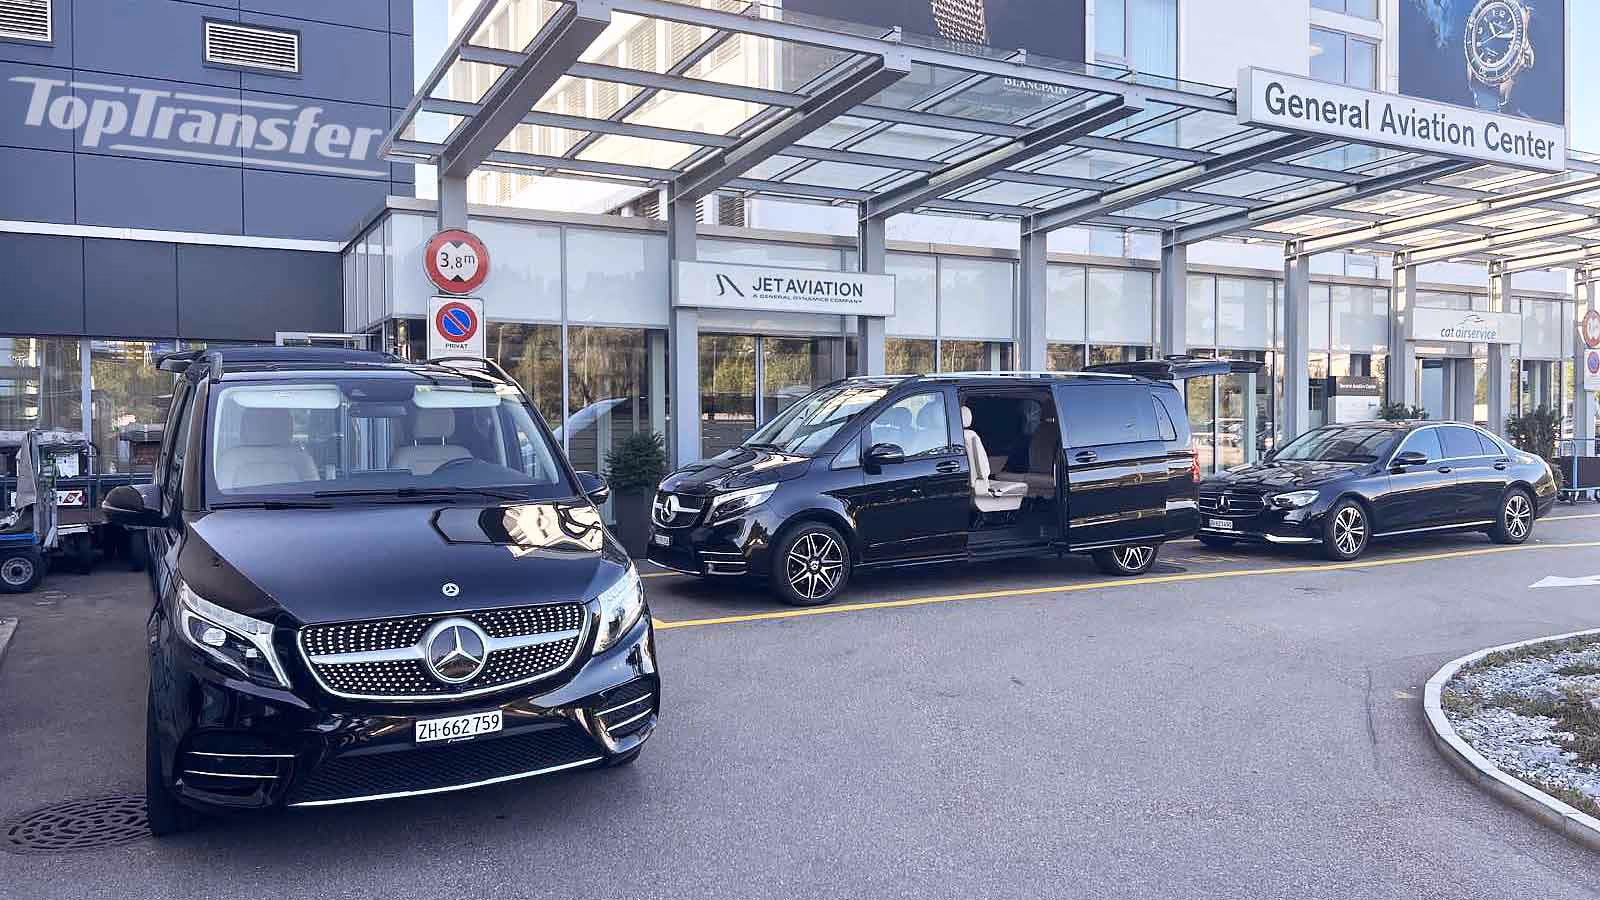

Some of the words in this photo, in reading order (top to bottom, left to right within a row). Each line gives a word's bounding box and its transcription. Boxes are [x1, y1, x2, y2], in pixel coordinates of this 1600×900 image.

[1264, 82, 1370, 130] General
[1380, 103, 1475, 148] Aviation
[1484, 121, 1555, 161] Center
[752, 276, 784, 292] JET
[785, 279, 863, 297] AVIATION
[1456, 328, 1496, 340] airservice
